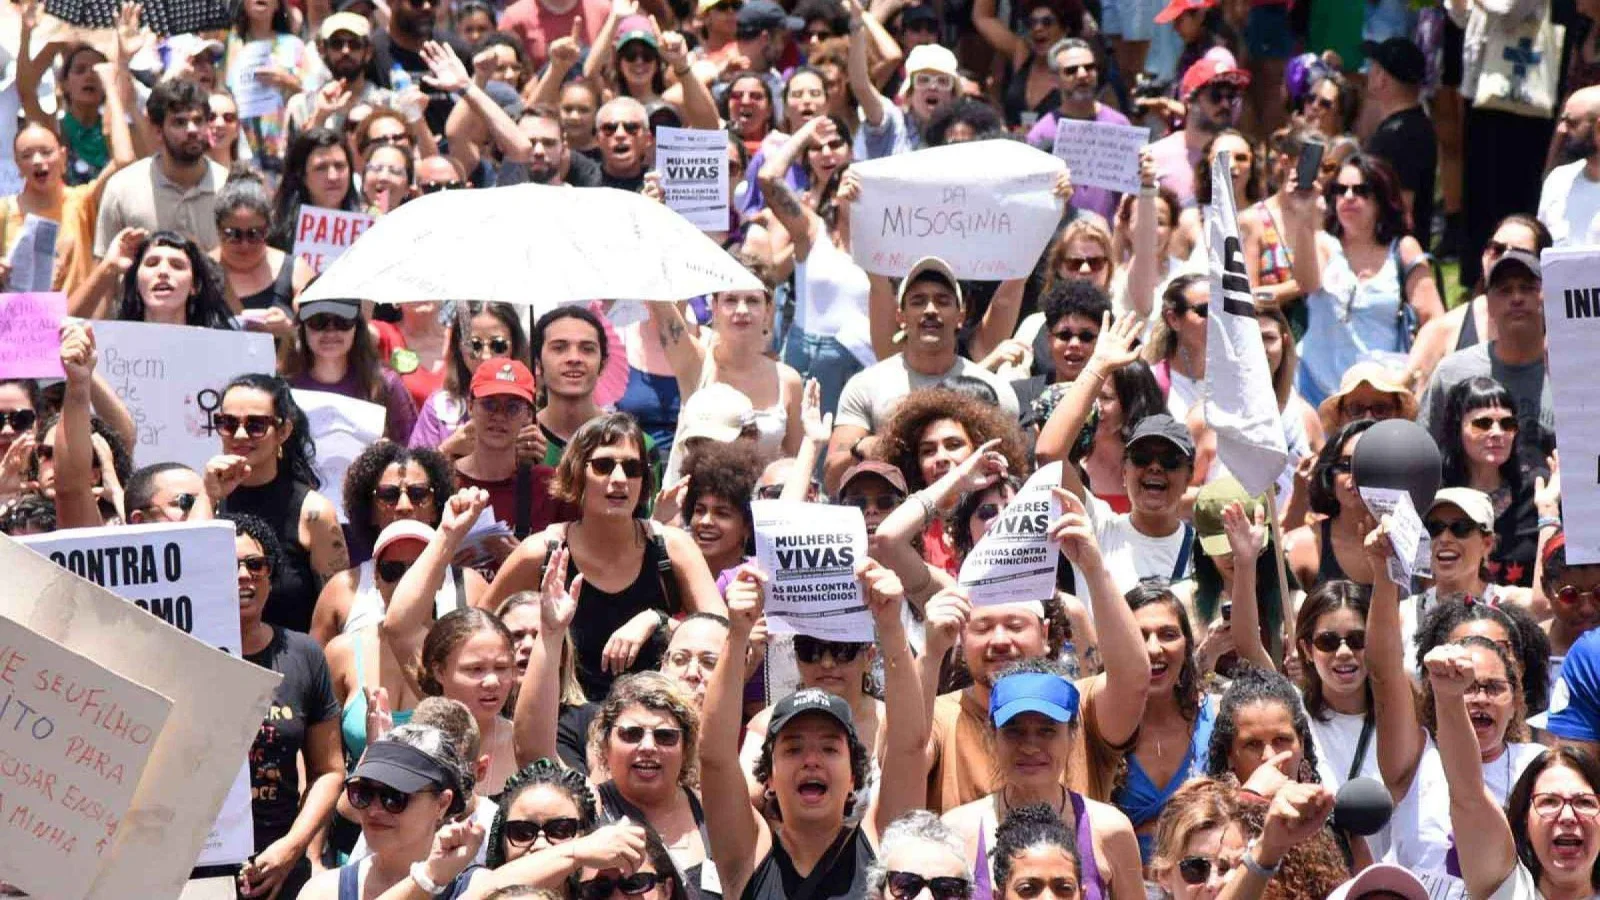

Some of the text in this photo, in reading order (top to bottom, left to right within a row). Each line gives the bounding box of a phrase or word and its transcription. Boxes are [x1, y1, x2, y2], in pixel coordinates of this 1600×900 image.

[666, 157, 719, 165] MULHERES
[667, 166, 719, 179] VIVAS
[943, 187, 967, 204] DA
[300, 213, 375, 246] PARE
[881, 206, 1012, 239] MISOGINIA
[104, 348, 165, 379] Parem
[116, 378, 140, 402] de
[1003, 501, 1049, 515] HERES
[988, 514, 1049, 534] IVAS
[775, 533, 853, 548] MULHERES
[164, 542, 181, 582] O
[775, 546, 855, 569] VIVAS
[1011, 547, 1047, 557] CONTRA
[786, 583, 813, 593] RUAS
[815, 581, 857, 593] CONTRA
[264, 705, 293, 720] RO
[65, 735, 123, 784] PARA
[8, 805, 77, 853] MINHA
